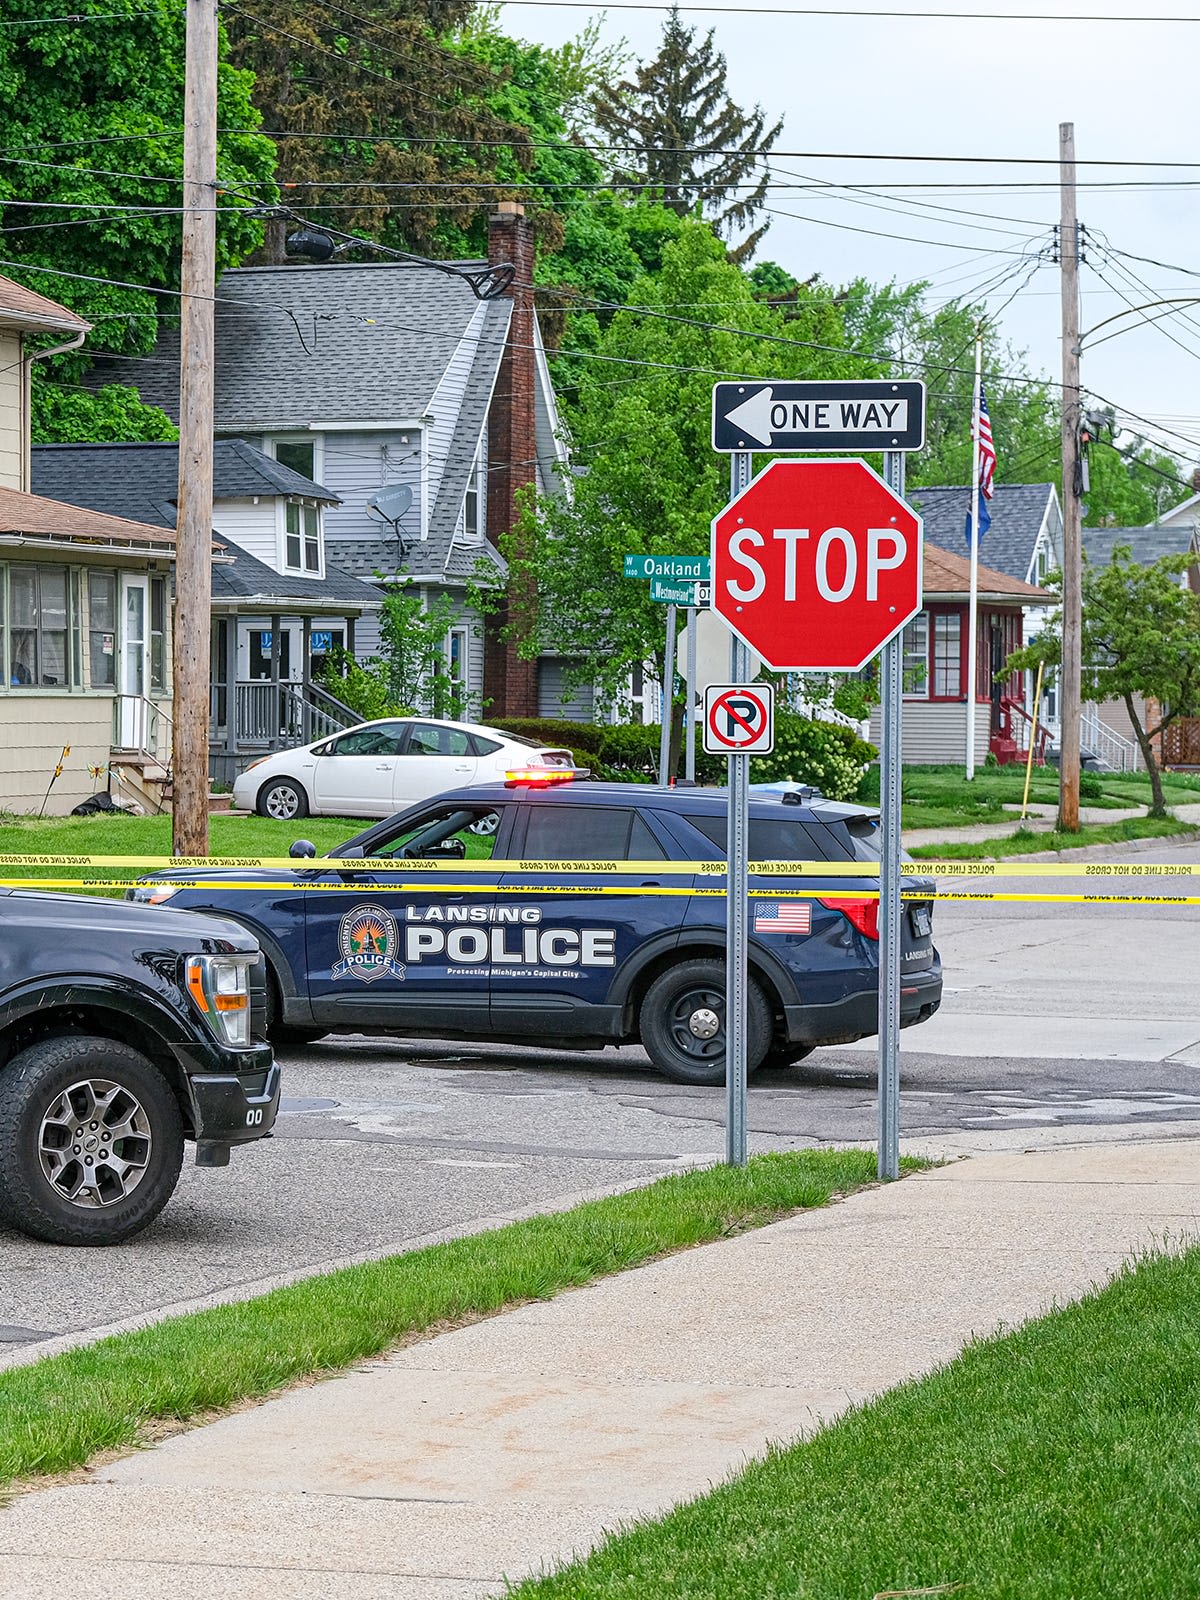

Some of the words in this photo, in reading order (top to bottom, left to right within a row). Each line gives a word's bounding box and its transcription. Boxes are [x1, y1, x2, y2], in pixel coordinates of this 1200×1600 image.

[770, 403, 830, 429] ONE
[840, 403, 900, 428] WAY
[626, 557, 633, 566] W
[643, 558, 701, 576] Oakland
[726, 527, 907, 603] STOP
[407, 906, 542, 923] LANSING
[342, 919, 352, 955] LANSING
[406, 926, 616, 965] POLICE
[346, 954, 392, 967] POLICE
[446, 968, 490, 976] Protecting
[491, 968, 532, 977] Michigan's
[533, 969, 561, 978] Capital
[562, 970, 580, 978] City
[245, 1108, 263, 1126] 00
